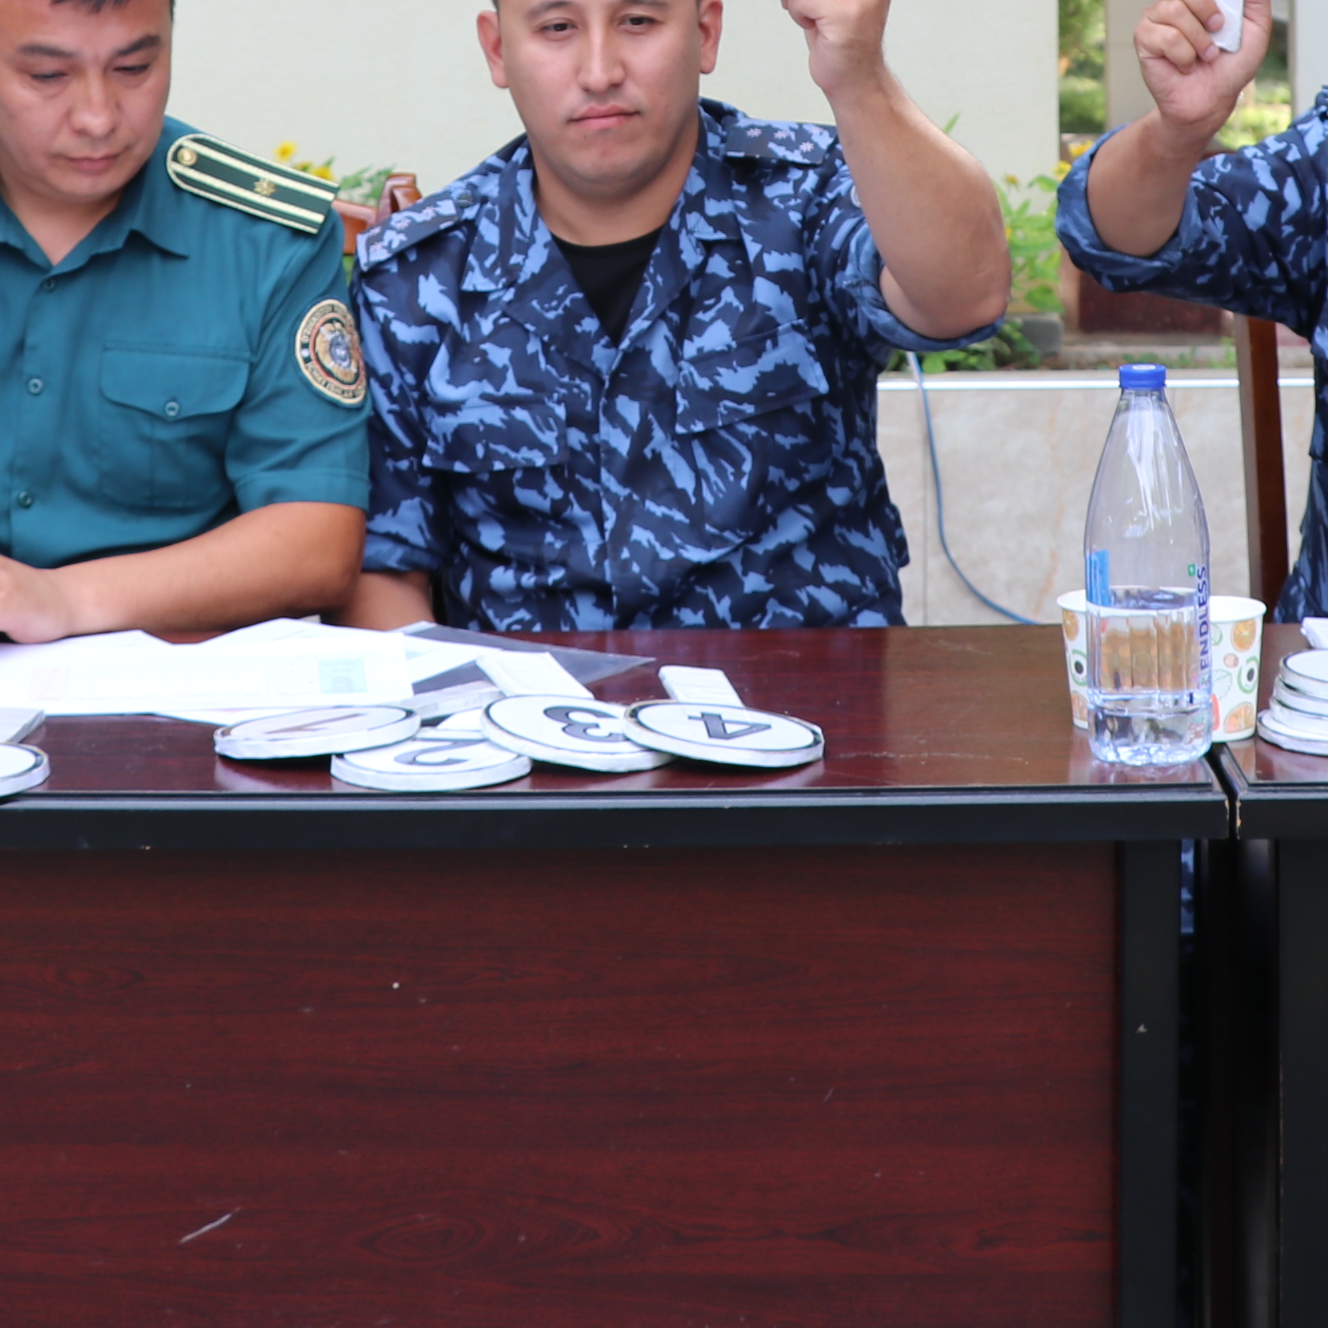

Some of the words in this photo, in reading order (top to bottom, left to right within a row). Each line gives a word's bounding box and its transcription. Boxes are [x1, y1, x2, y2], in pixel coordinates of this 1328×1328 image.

[1196, 565, 1210, 671] ENDLESS
[542, 705, 630, 743] 3
[687, 711, 772, 740] 4
